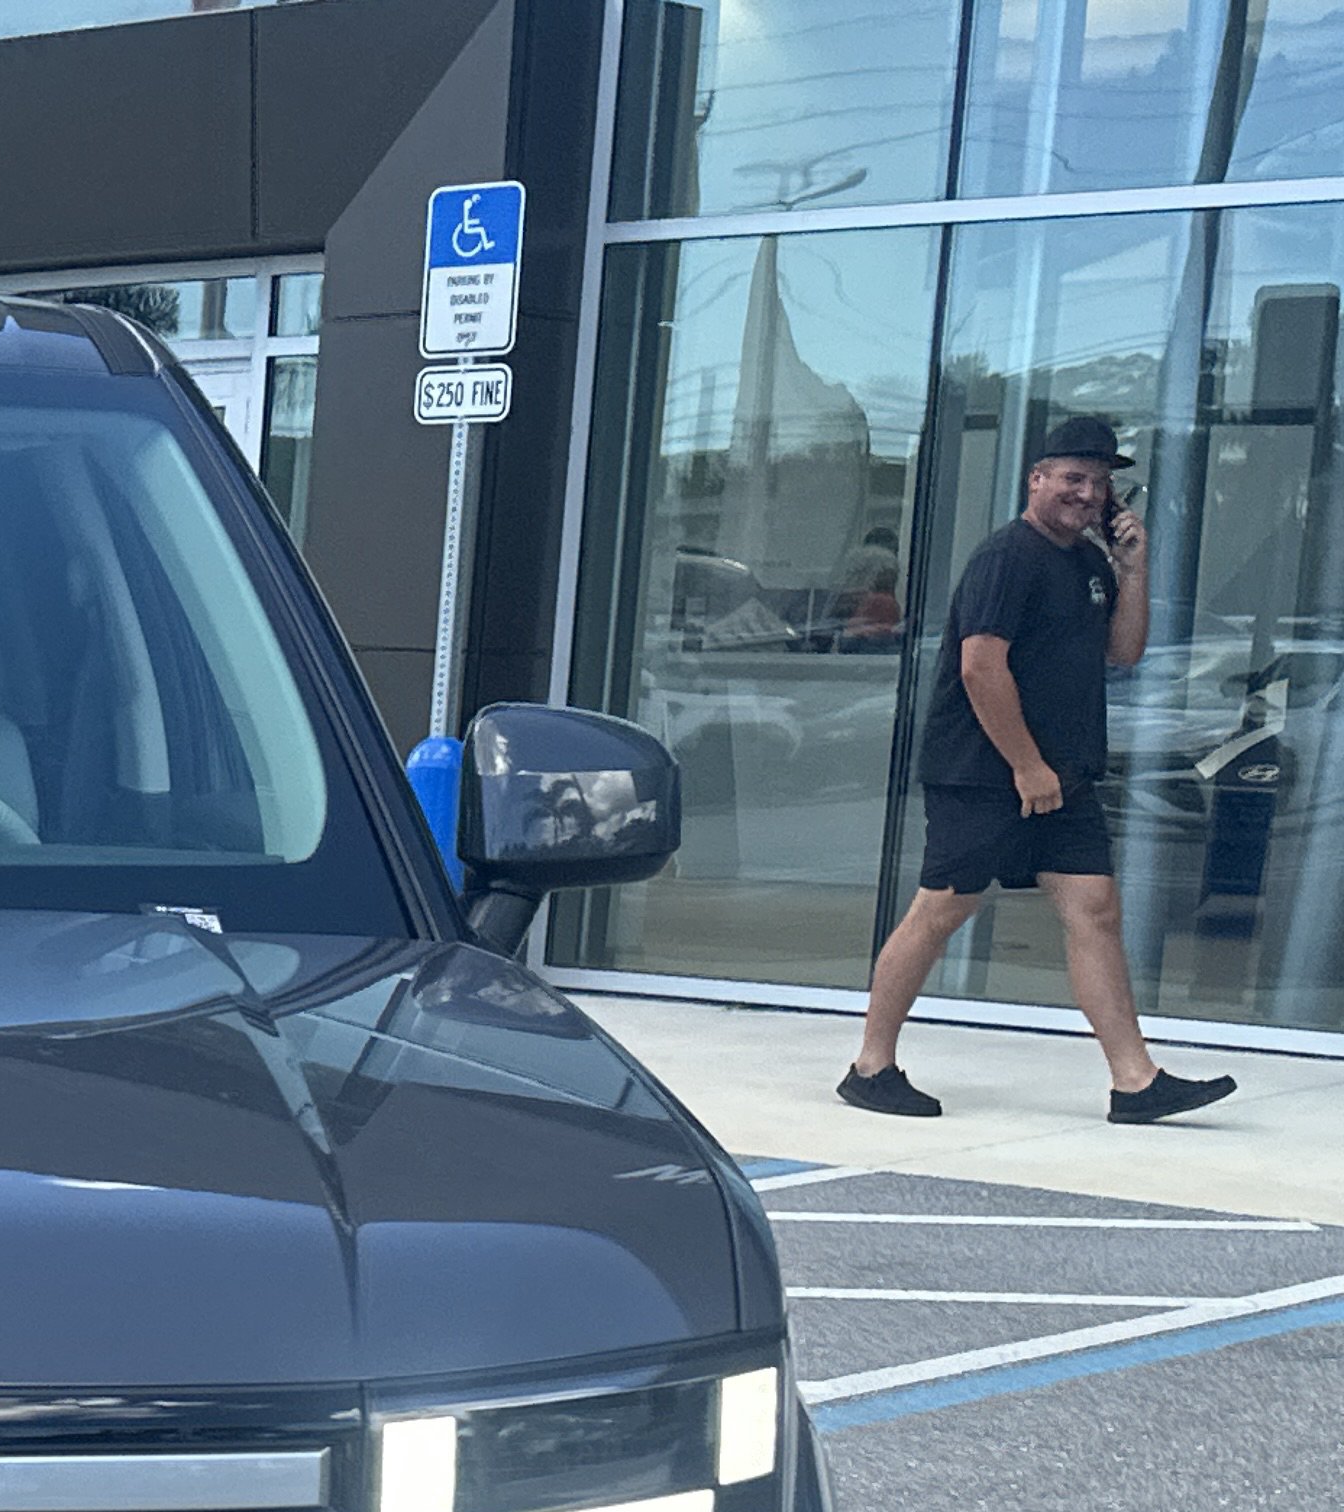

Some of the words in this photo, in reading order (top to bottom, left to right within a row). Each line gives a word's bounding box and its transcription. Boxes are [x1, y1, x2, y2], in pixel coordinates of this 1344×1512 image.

[450, 292, 489, 306] DISABLED
[423, 382, 464, 409] $250
[472, 381, 502, 405] FINE
